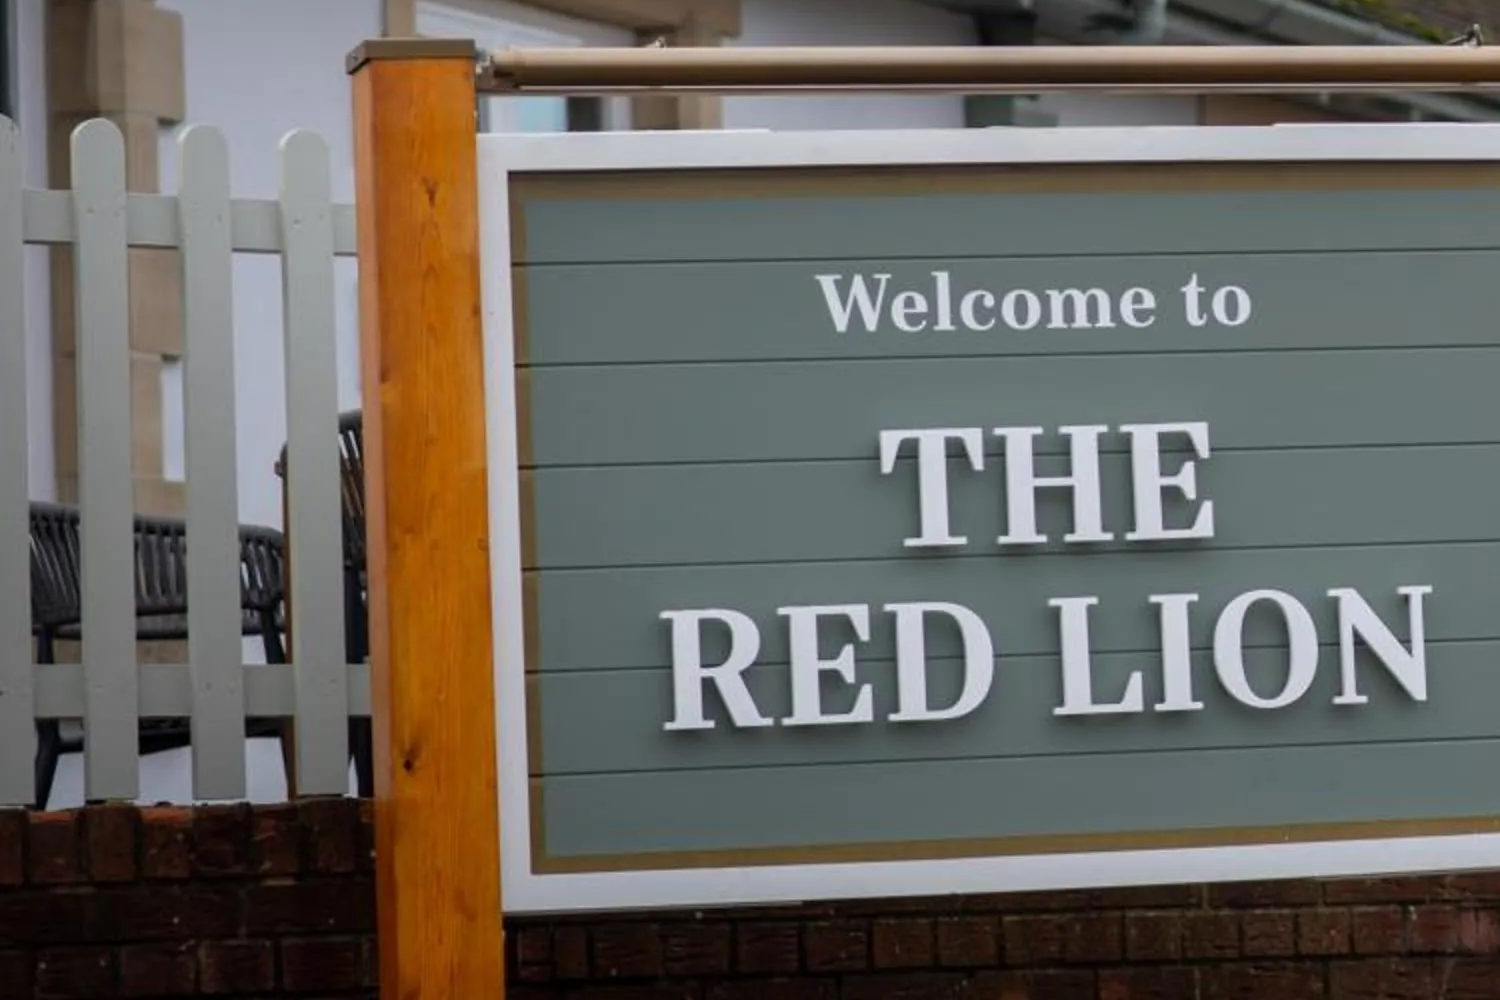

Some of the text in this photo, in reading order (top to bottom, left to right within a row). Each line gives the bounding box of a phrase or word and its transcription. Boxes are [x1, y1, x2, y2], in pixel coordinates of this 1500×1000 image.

[816, 271, 1251, 331] Welcome to
[879, 421, 1214, 546] THE
[659, 585, 1433, 730] RED LION
